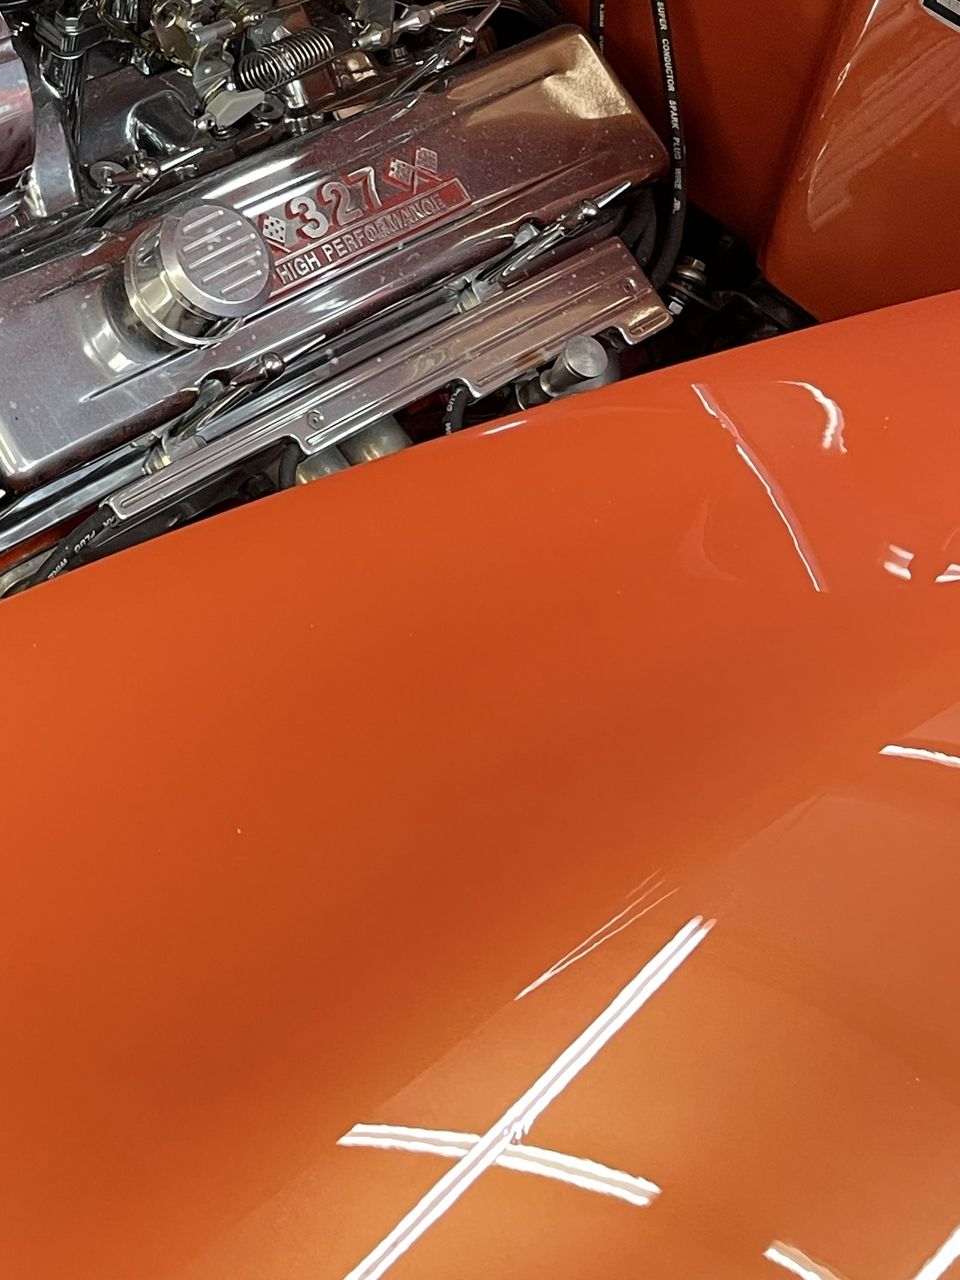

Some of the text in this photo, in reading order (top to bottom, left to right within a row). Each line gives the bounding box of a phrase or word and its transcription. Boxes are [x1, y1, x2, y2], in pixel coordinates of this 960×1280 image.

[657, 1, 668, 31] SUPER
[662, 38, 676, 92] CONDUCTOR
[668, 99, 679, 130] SPARK
[672, 136, 682, 160] PLUG
[290, 166, 382, 239] 327
[275, 193, 448, 285] HIGH PERFORMANCE
